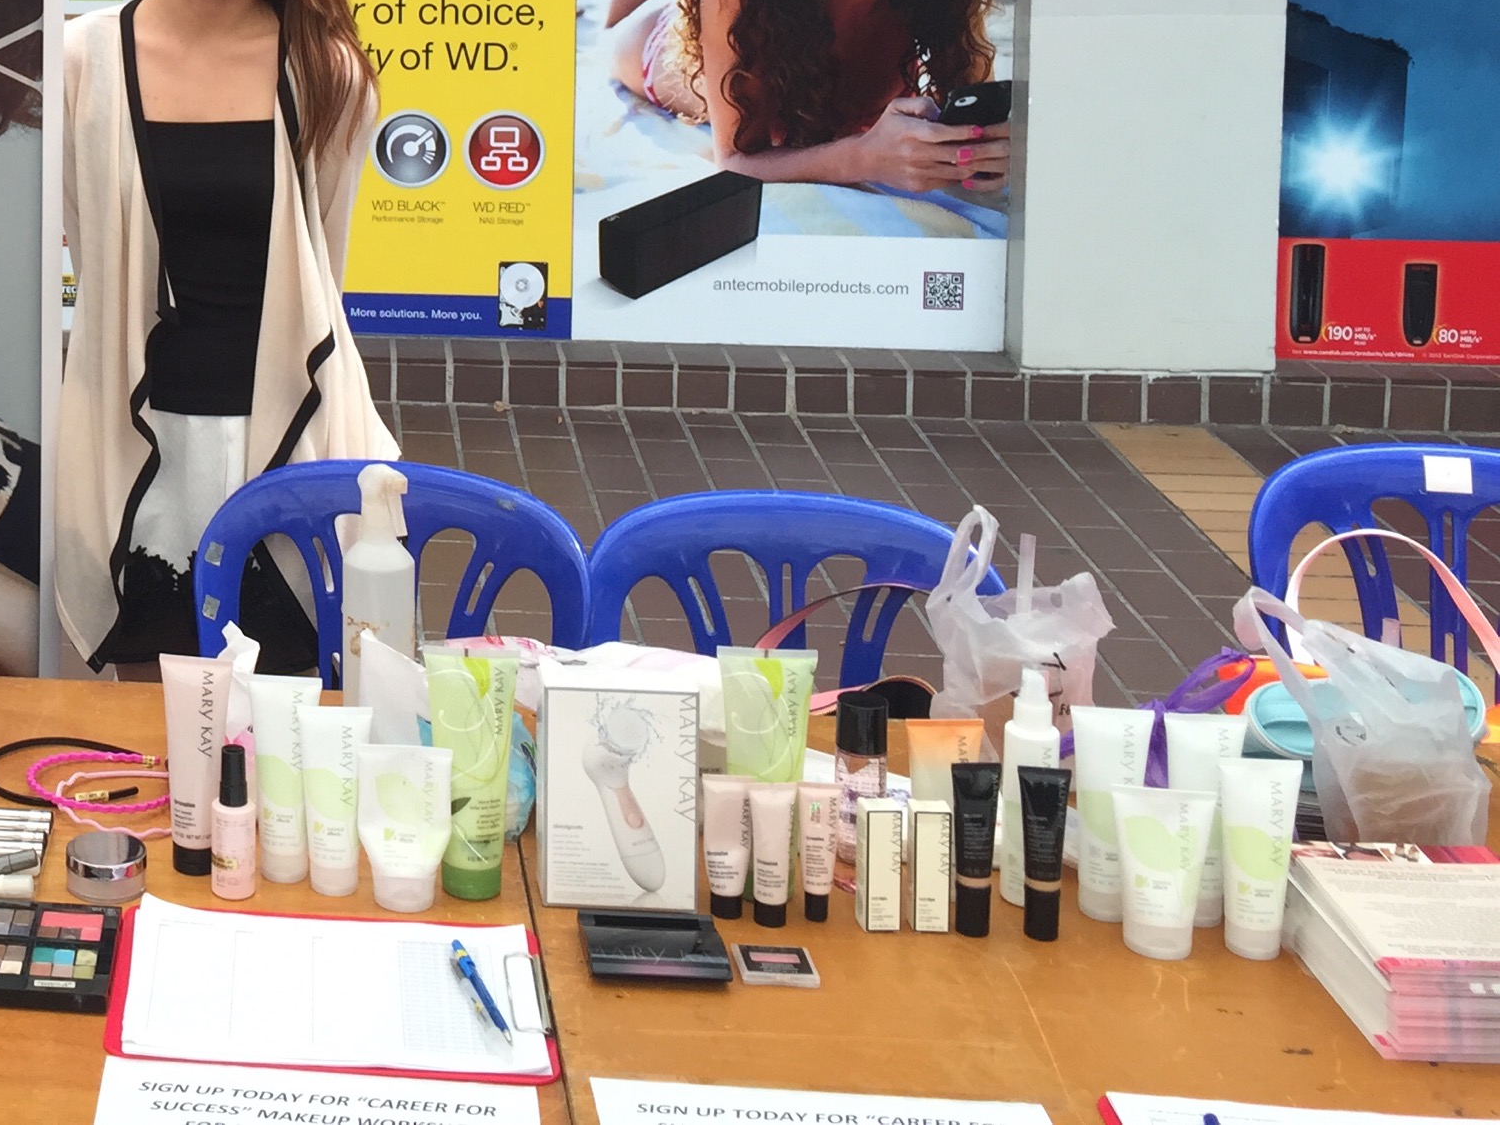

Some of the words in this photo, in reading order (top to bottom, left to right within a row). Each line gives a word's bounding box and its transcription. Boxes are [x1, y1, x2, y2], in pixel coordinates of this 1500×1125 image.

[363, 42, 394, 75] ty
[400, 42, 434, 71] of
[372, 200, 393, 212] WD
[473, 202, 495, 213] WD
[712, 277, 910, 297] antecmobileproducts.com
[350, 307, 377, 318] More
[379, 308, 429, 319] solutions.
[431, 310, 458, 320] More
[460, 311, 483, 322] you.
[1327, 326, 1353, 341] 190
[1438, 329, 1459, 344] 80
[494, 667, 504, 693] KAY
[788, 667, 798, 697] KAY
[198, 670, 214, 721] MARY
[495, 696, 504, 736] MARY
[674, 693, 697, 764] MARY
[786, 701, 798, 738] MARY
[197, 724, 213, 759] KAY
[338, 725, 354, 772] MARY
[956, 735, 971, 765] MAR
[1120, 723, 1135, 774] MARY
[338, 775, 353, 807] KAY
[673, 775, 697, 824] KAY
[1268, 780, 1284, 830] MARY
[740, 798, 750, 827] MARY
[828, 797, 837, 828] MARY
[1177, 802, 1190, 842] MARY
[740, 830, 749, 850] KAY
[828, 833, 837, 854] KAY
[890, 813, 902, 848] MARY
[937, 813, 951, 849] MARY
[890, 851, 902, 876] KAY
[937, 852, 950, 876] KAY
[1177, 844, 1190, 872] KAY
[1269, 834, 1284, 868] KAY
[138, 1081, 189, 1093] SIGN
[195, 1085, 225, 1096] UP
[231, 1088, 303, 1103] TODAY
[308, 1093, 350, 1107] FOR
[454, 1103, 497, 1117] FOR
[636, 1102, 688, 1116] SIGN
[696, 1106, 725, 1117] UP
[732, 1108, 808, 1123] TODAY
[816, 1112, 858, 1125] FOR
[257, 1109, 350, 1125] MAKEUP
